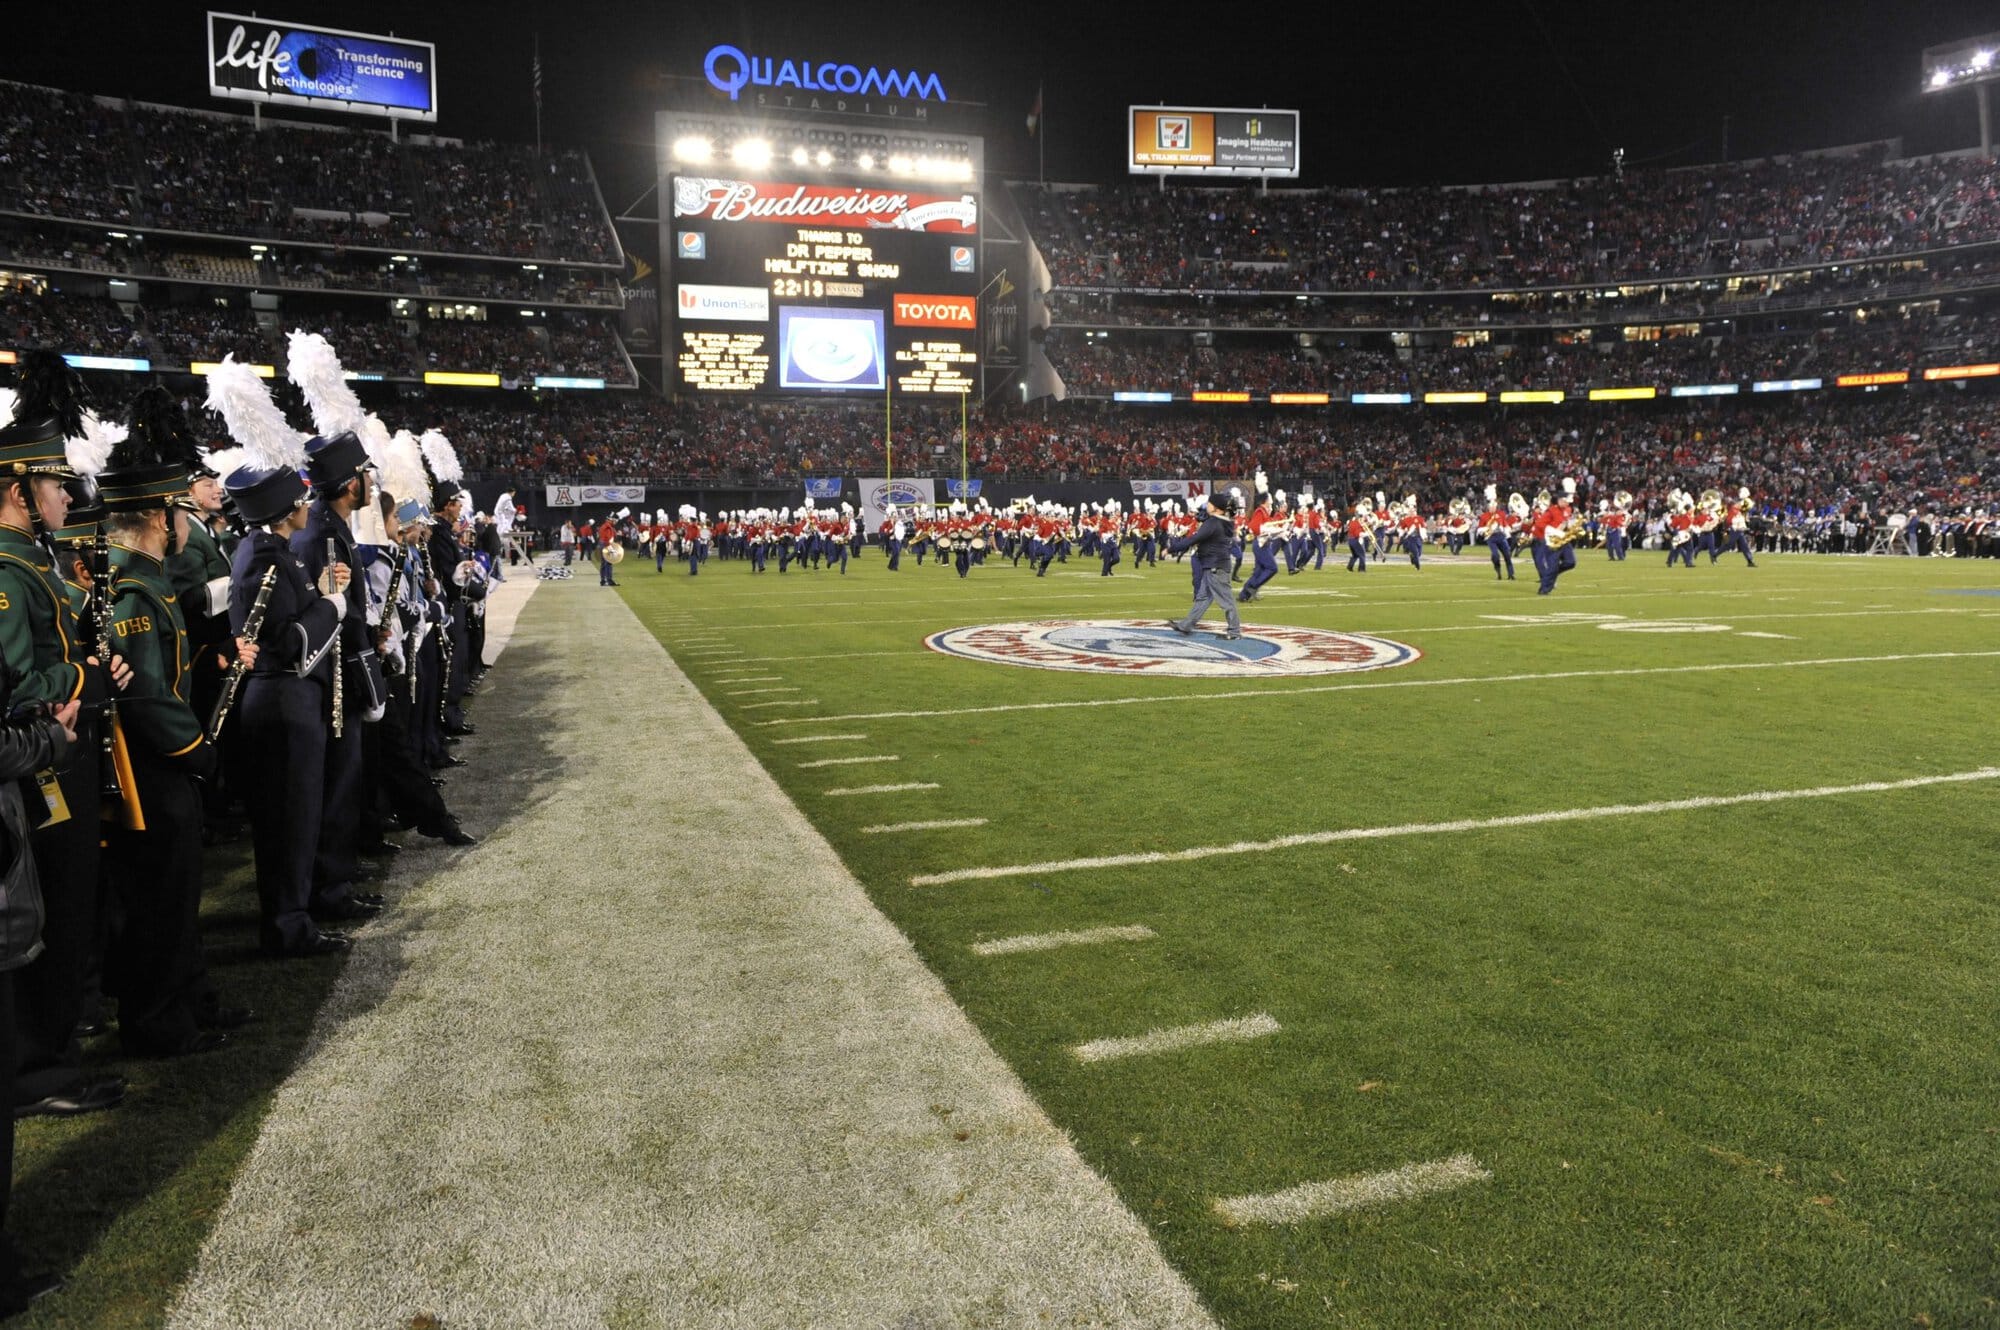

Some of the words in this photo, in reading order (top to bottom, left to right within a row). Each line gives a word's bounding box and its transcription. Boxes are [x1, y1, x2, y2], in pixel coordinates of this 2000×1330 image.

[216, 24, 291, 89] life
[336, 47, 423, 72] Transforming
[356, 64, 405, 80] science
[703, 44, 947, 102] QUALCOMM
[757, 93, 928, 117] STADIUM
[1217, 136, 1250, 148] Imaging
[1250, 137, 1293, 148] Healthcare
[702, 183, 908, 221] Budweiser
[797, 229, 843, 244] THANKS
[846, 232, 863, 245] TO
[786, 243, 810, 258] DR
[814, 244, 873, 262] PEPPER
[764, 258, 849, 277] HALFTIME
[856, 263, 900, 279] SHOW
[623, 286, 657, 300] Sprint
[897, 302, 972, 321] TOYOTA
[1839, 376, 1872, 385] WELLS
[1874, 373, 1908, 383] FARGO
[555, 487, 575, 505] A
[1188, 481, 1205, 498] N
[114, 615, 152, 638] UHS
